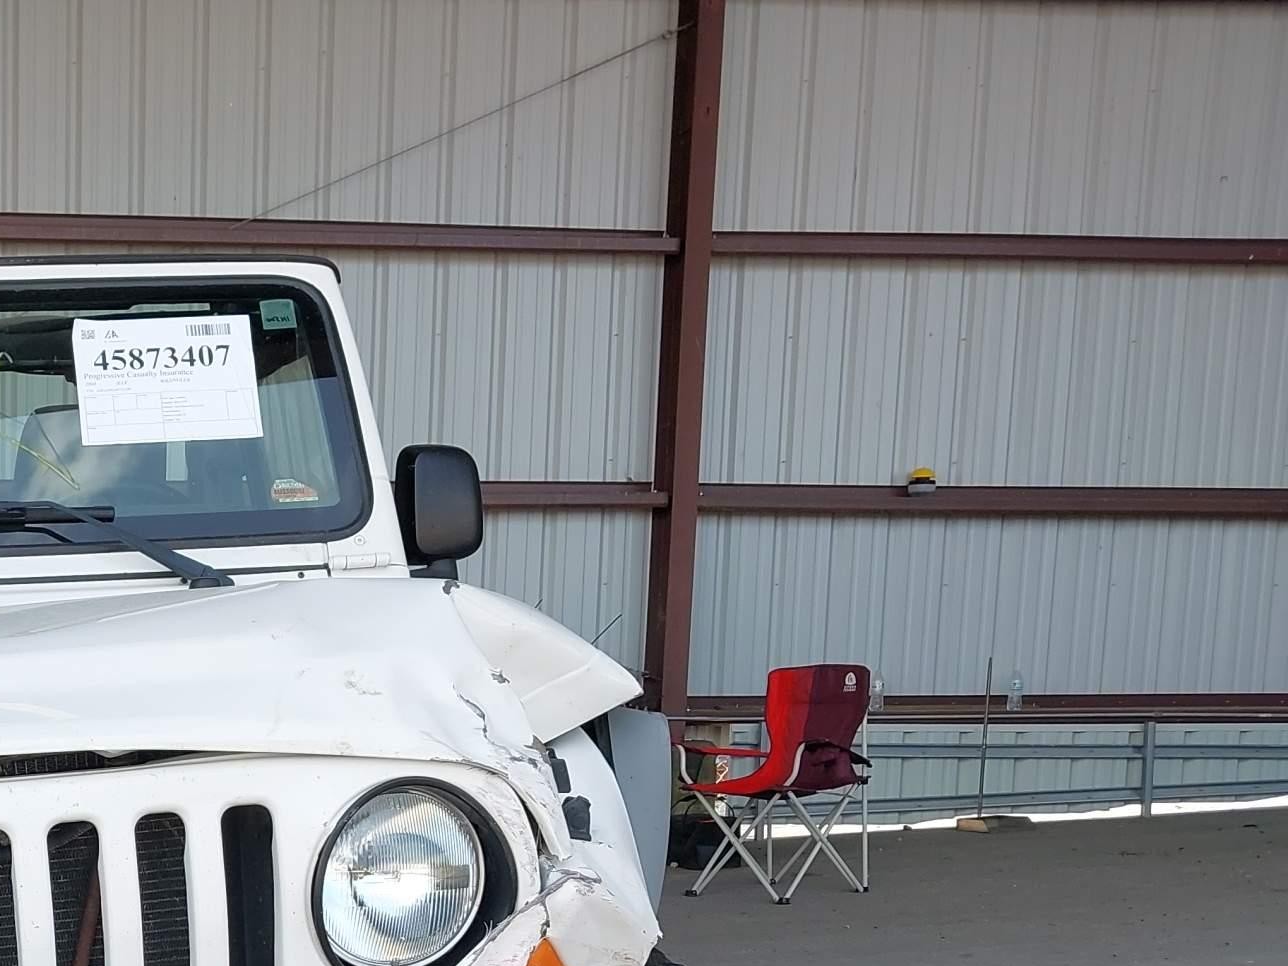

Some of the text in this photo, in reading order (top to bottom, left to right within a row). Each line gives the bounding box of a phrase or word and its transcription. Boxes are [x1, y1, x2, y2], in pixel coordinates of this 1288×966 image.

[94, 345, 230, 370] 45873407
[84, 372, 125, 381] Progressive
[127, 370, 158, 378] Casualty
